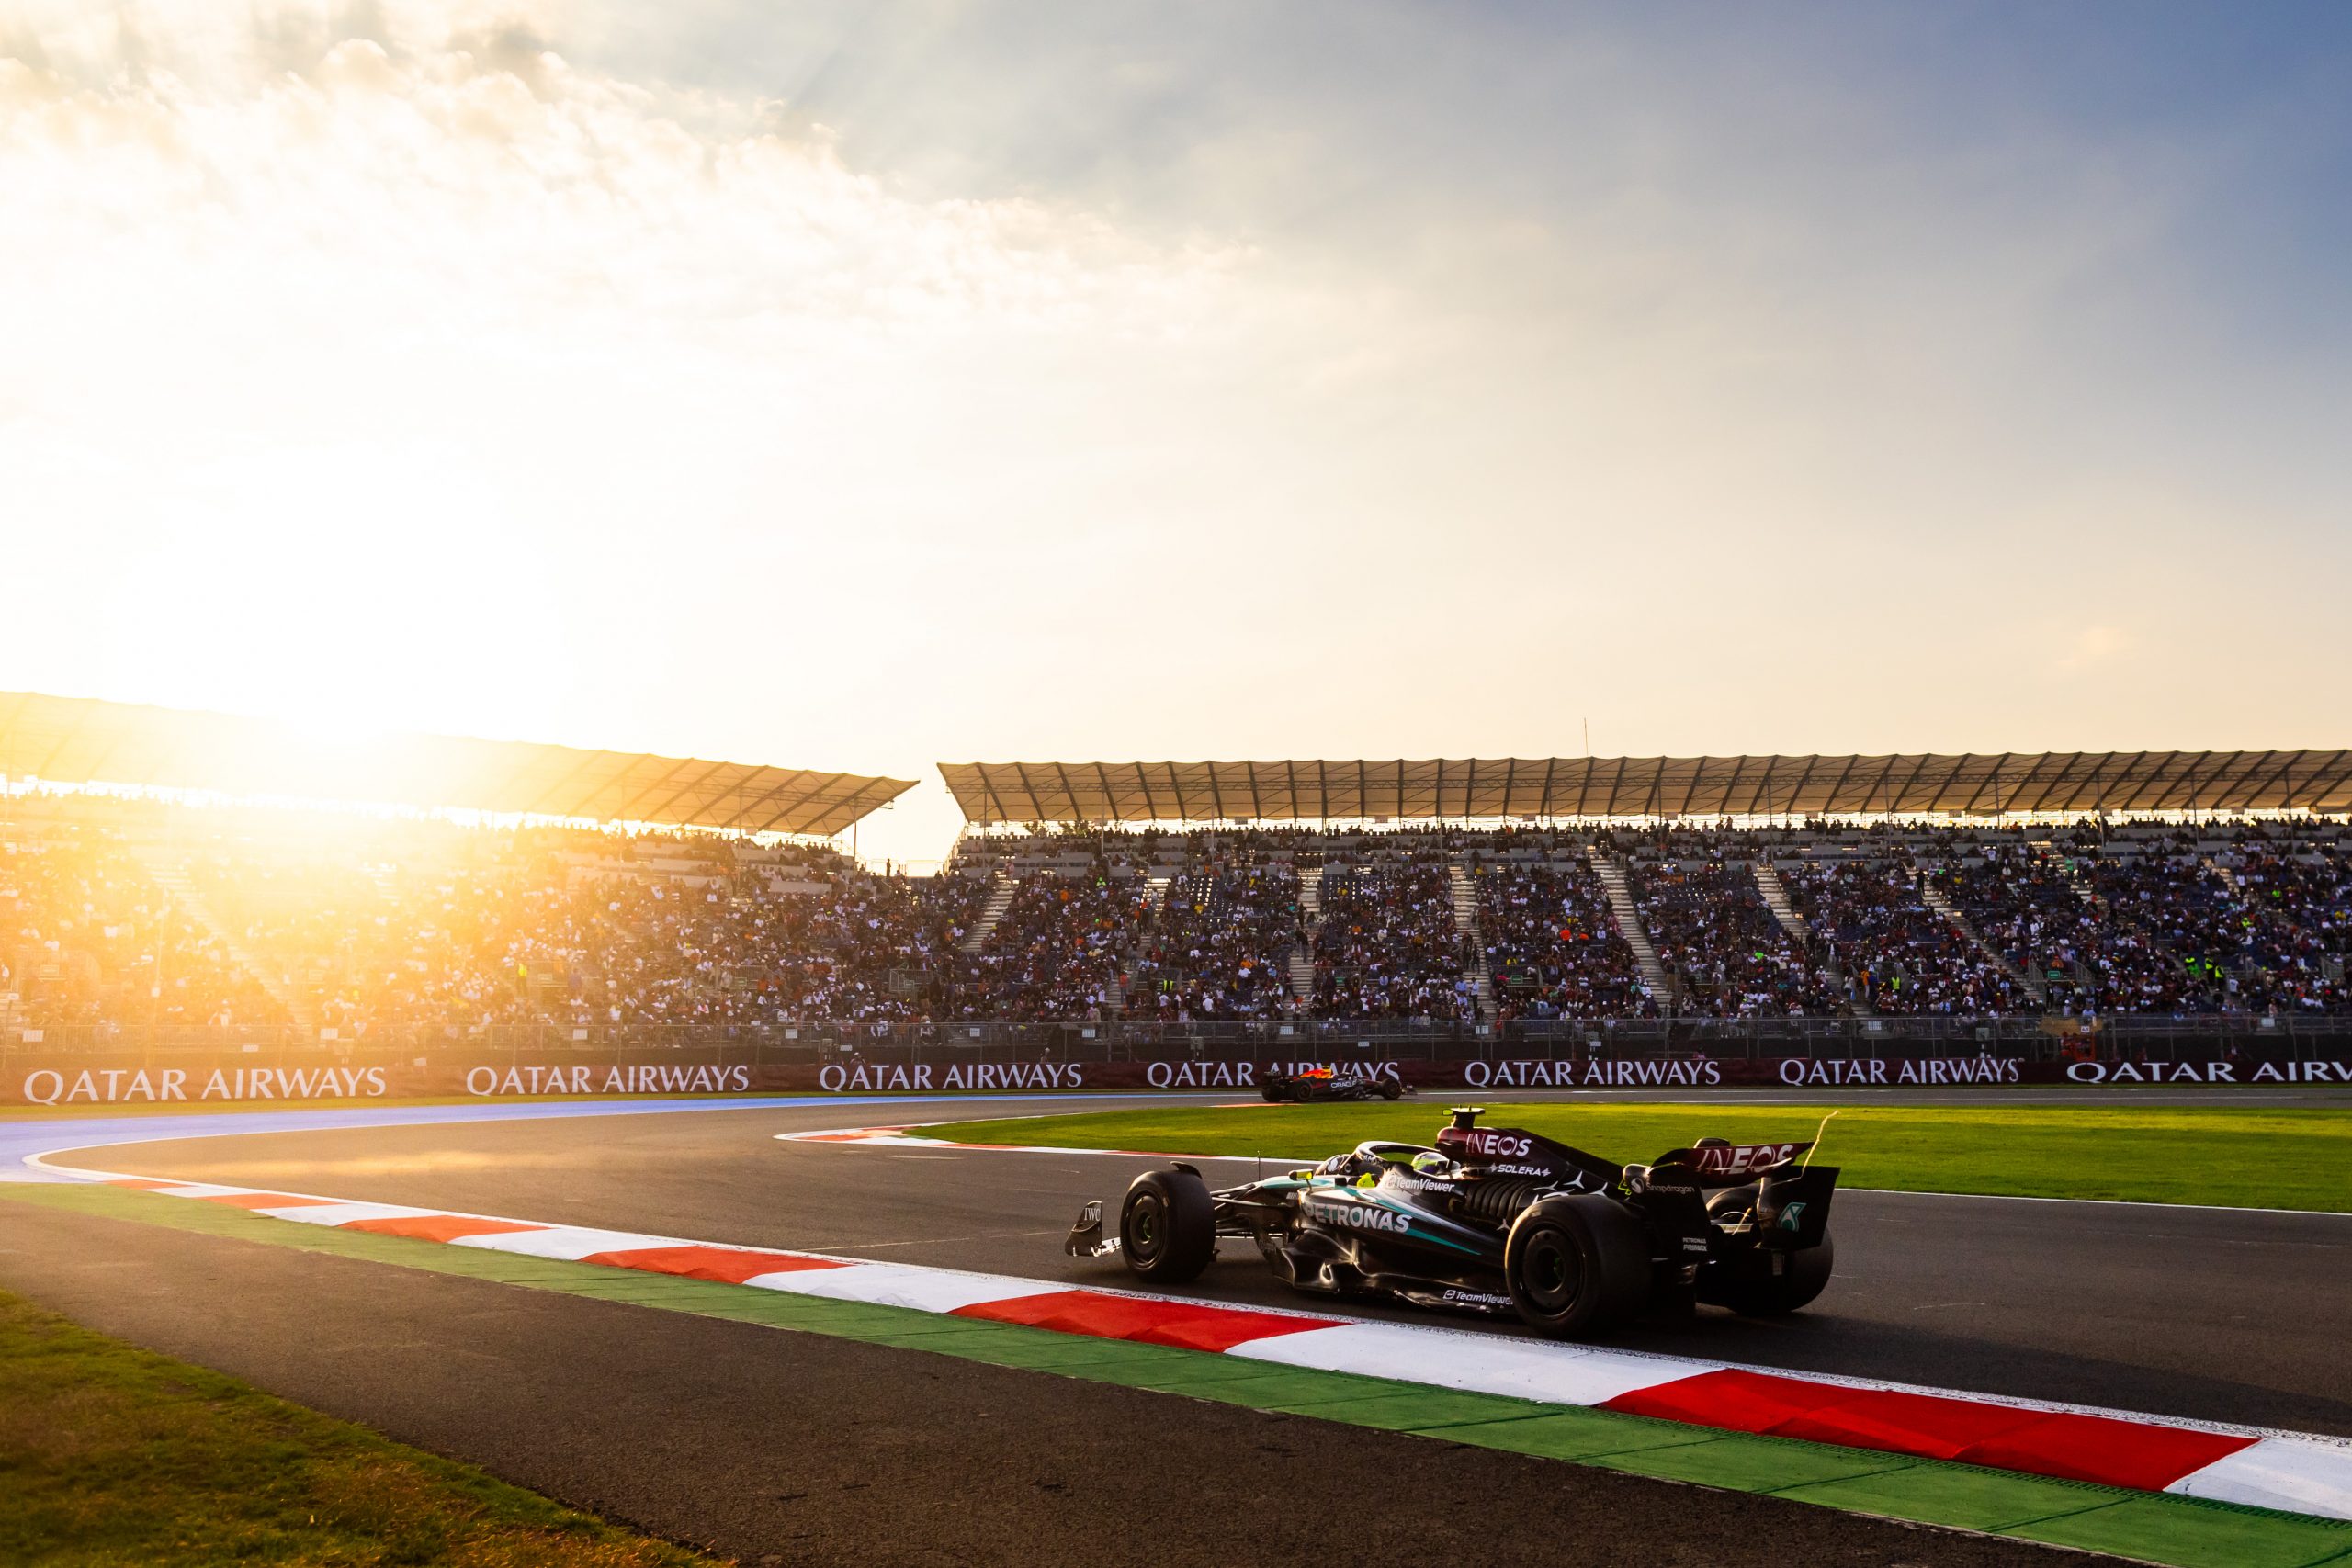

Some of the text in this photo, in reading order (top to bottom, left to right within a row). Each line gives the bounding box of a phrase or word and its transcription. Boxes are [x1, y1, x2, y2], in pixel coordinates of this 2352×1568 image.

[466, 1066, 749, 1097] QATAR AIRWAYS
[819, 1063, 1083, 1092] QATAR AIRWAYS
[1147, 1062, 1256, 1088] QATAR
[1464, 1060, 1721, 1089] QATAR AIRWAYS
[1779, 1058, 2019, 1087] QATAR AIRWAYS
[2067, 1061, 2238, 1084] QATAR
[23, 1066, 387, 1106] QATAR AIRWAYS
[1465, 1133, 1532, 1157] INEOS
[1497, 1164, 1542, 1177] SOLERA
[1695, 1144, 1794, 1175] INEOS
[1396, 1176, 1455, 1193] TeamViewer
[1646, 1183, 1695, 1195] Snapdragon
[1084, 1207, 1101, 1221] IWC
[1305, 1202, 1413, 1233] PETRONAS
[1455, 1291, 1514, 1305] TeamViewe
